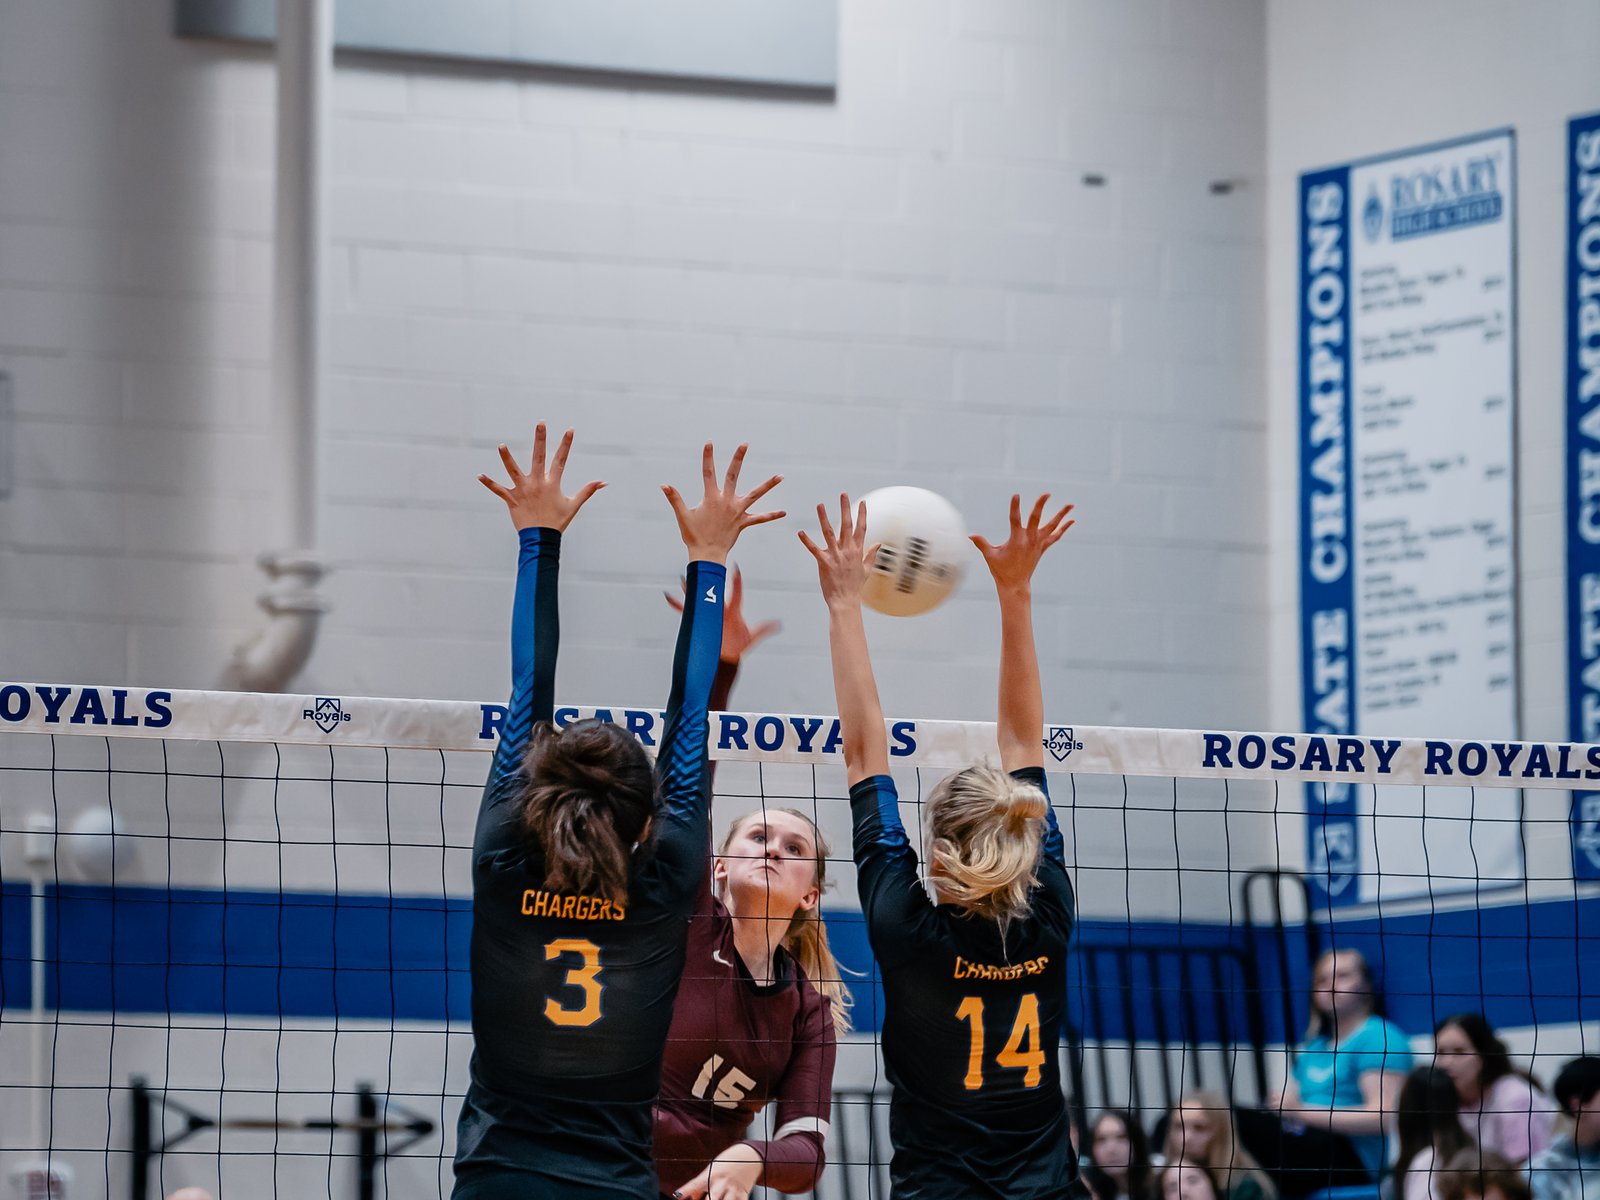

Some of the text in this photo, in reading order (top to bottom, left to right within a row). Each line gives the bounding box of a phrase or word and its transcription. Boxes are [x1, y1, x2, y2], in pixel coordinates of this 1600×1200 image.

[1307, 181, 1351, 804] SATE CHAMPIONS
[0, 685, 173, 728] OYALS
[303, 709, 351, 723] Royals
[718, 714, 917, 757] ROYAS
[1042, 739, 1084, 752] Royals
[1202, 733, 1600, 781] ROSARY ROYALS
[521, 889, 626, 921] CHARGERS
[544, 938, 605, 1027] 3
[955, 993, 1046, 1090] 14
